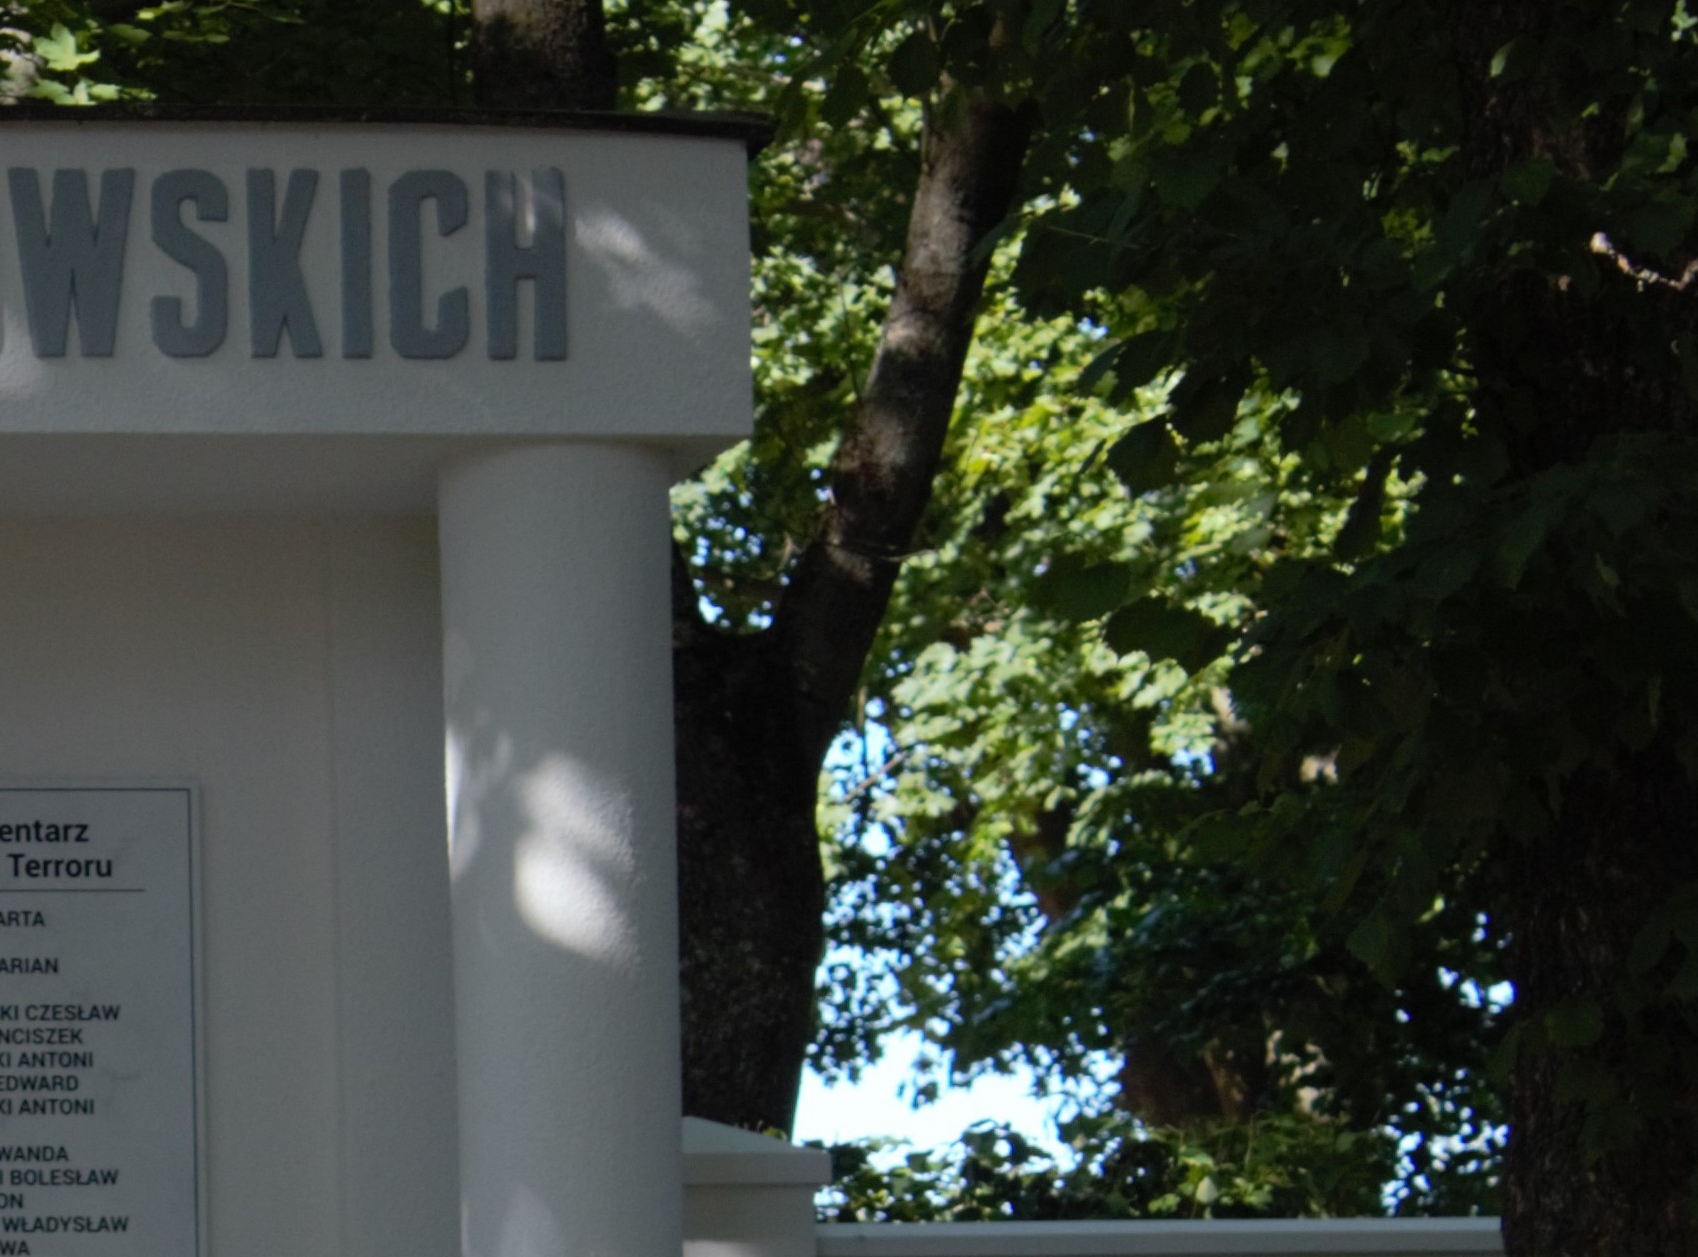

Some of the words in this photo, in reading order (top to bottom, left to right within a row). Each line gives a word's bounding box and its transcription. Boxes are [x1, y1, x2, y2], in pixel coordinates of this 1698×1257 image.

[7, 854, 112, 878] Terroru
[25, 1005, 121, 1021] CZESŁAW
[17, 1052, 93, 1068] ANTONI
[18, 1099, 94, 1115] ANTONI
[11, 1170, 119, 1185] BOLESŁAW
[2, 1217, 129, 1232] WŁADYSŁAW
